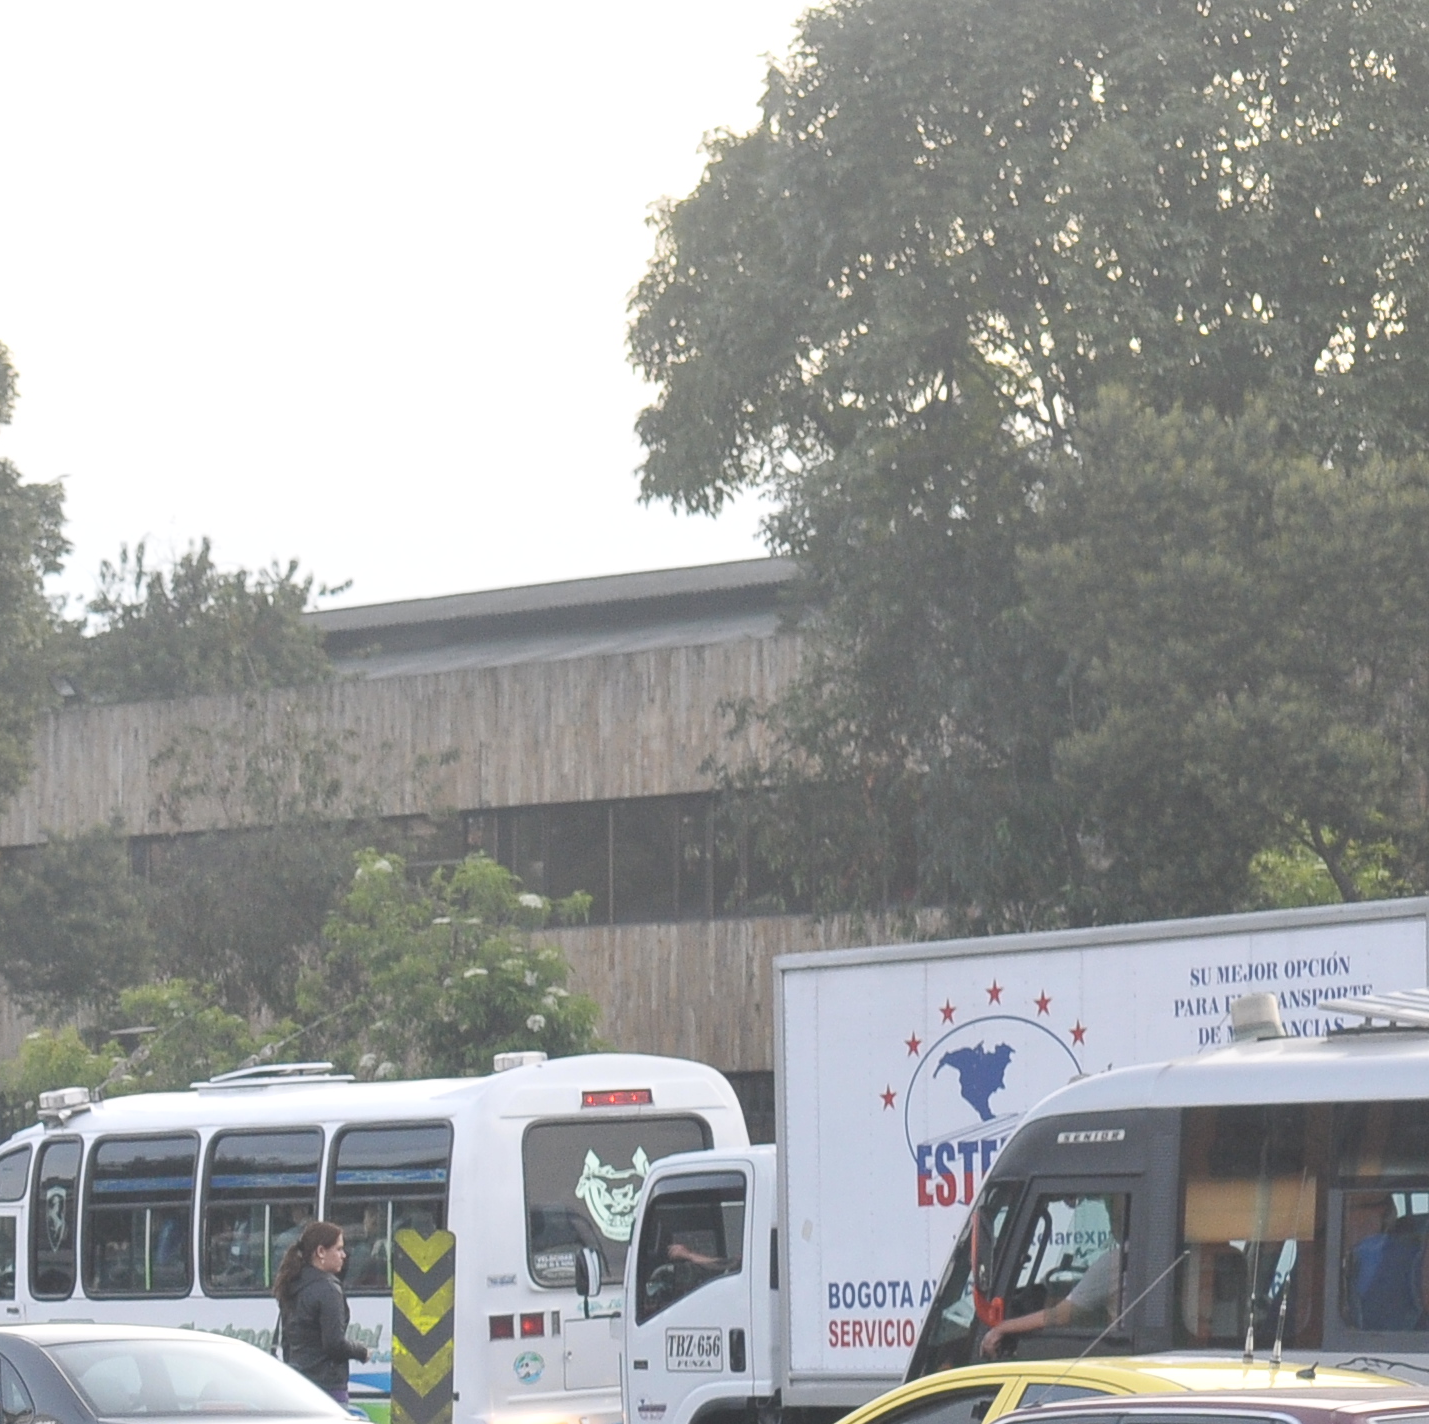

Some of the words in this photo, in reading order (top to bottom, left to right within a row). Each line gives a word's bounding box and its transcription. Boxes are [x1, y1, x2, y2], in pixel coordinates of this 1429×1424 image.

[1190, 967, 1212, 987] SU
[1217, 961, 1278, 985] MEJOR
[1284, 951, 1351, 978] OPCIÓN
[1174, 996, 1219, 1017] PARA
[1279, 984, 1373, 1009] ANSPORTE
[1199, 1026, 1222, 1046] DE
[1061, 1130, 1124, 1143] SENIOR
[828, 1281, 914, 1308] BOGOTA
[828, 1319, 915, 1348] SERVICIO
[677, 1360, 712, 1368] FUNZA
